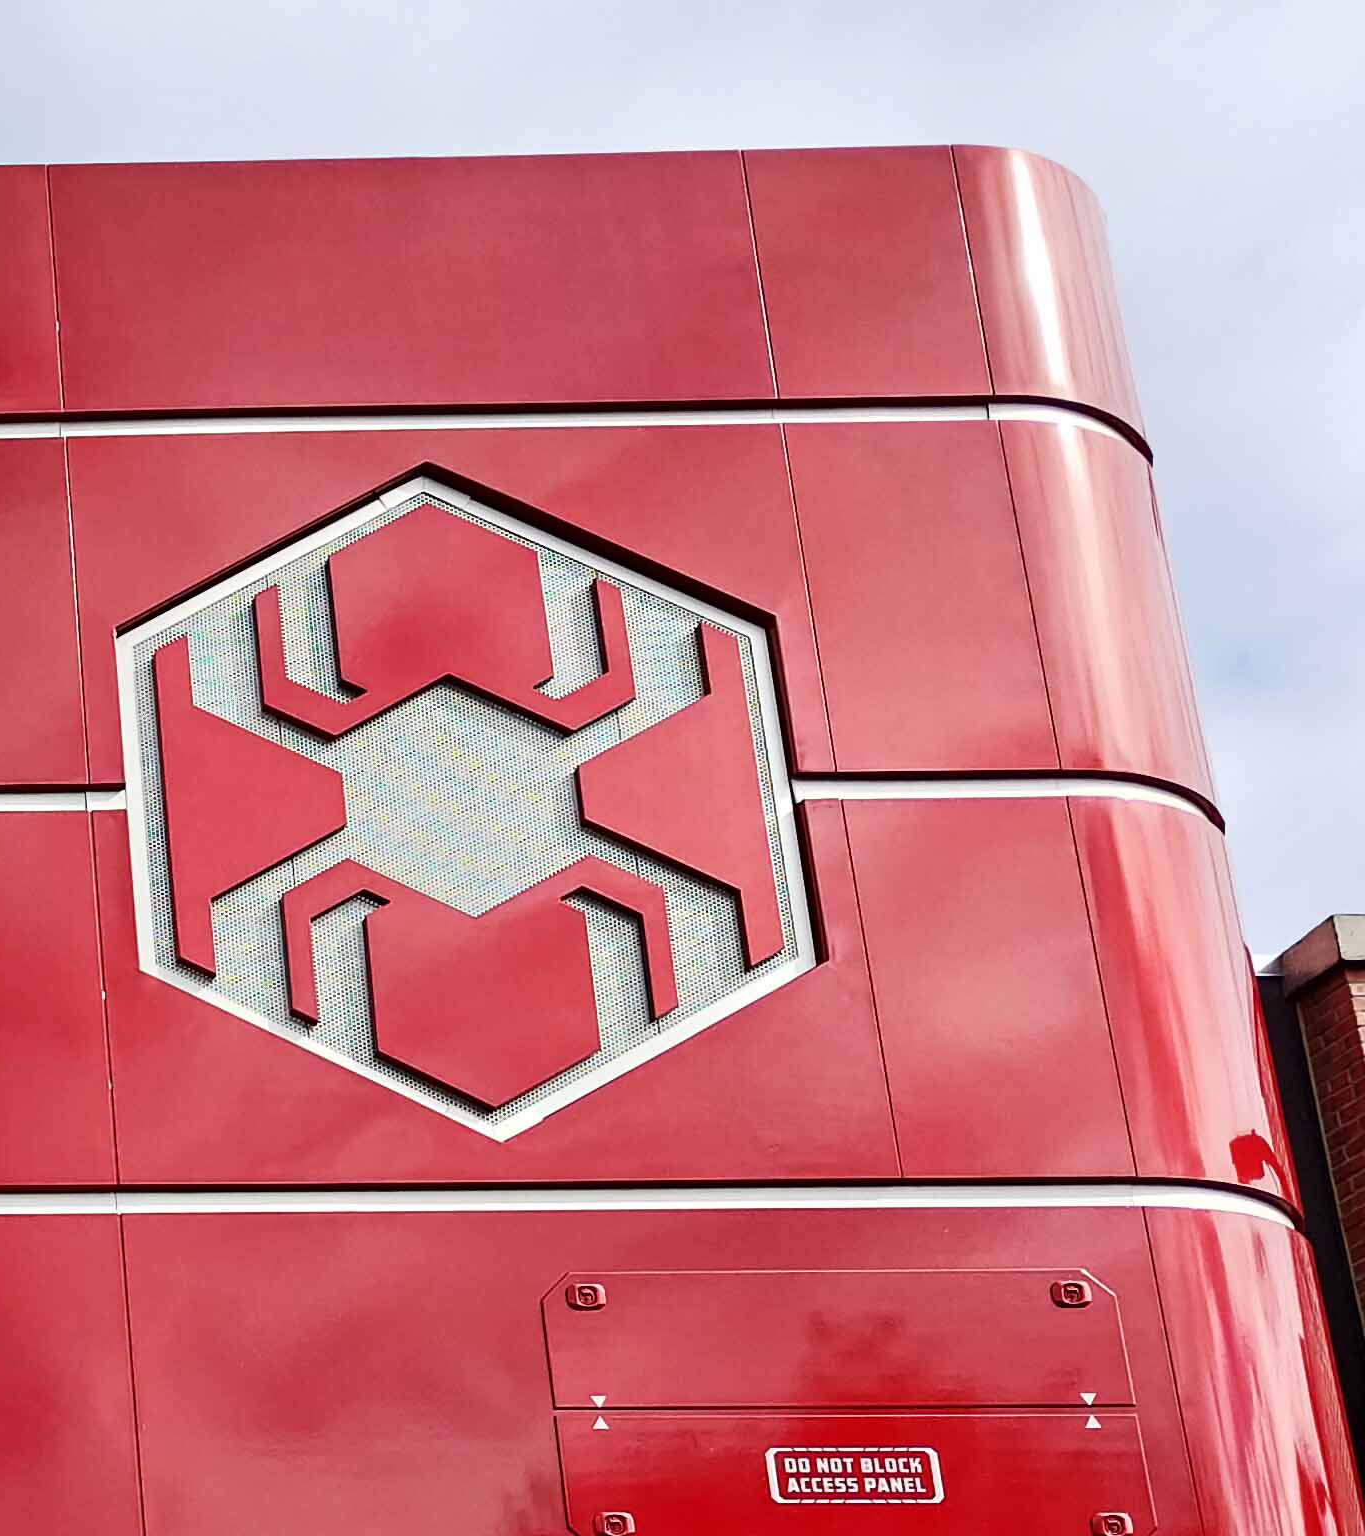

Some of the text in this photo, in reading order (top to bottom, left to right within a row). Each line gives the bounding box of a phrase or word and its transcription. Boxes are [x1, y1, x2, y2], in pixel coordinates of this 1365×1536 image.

[784, 1457, 923, 1474] DO NOT BLOCK
[787, 1477, 927, 1494] ACCESS PANEL
